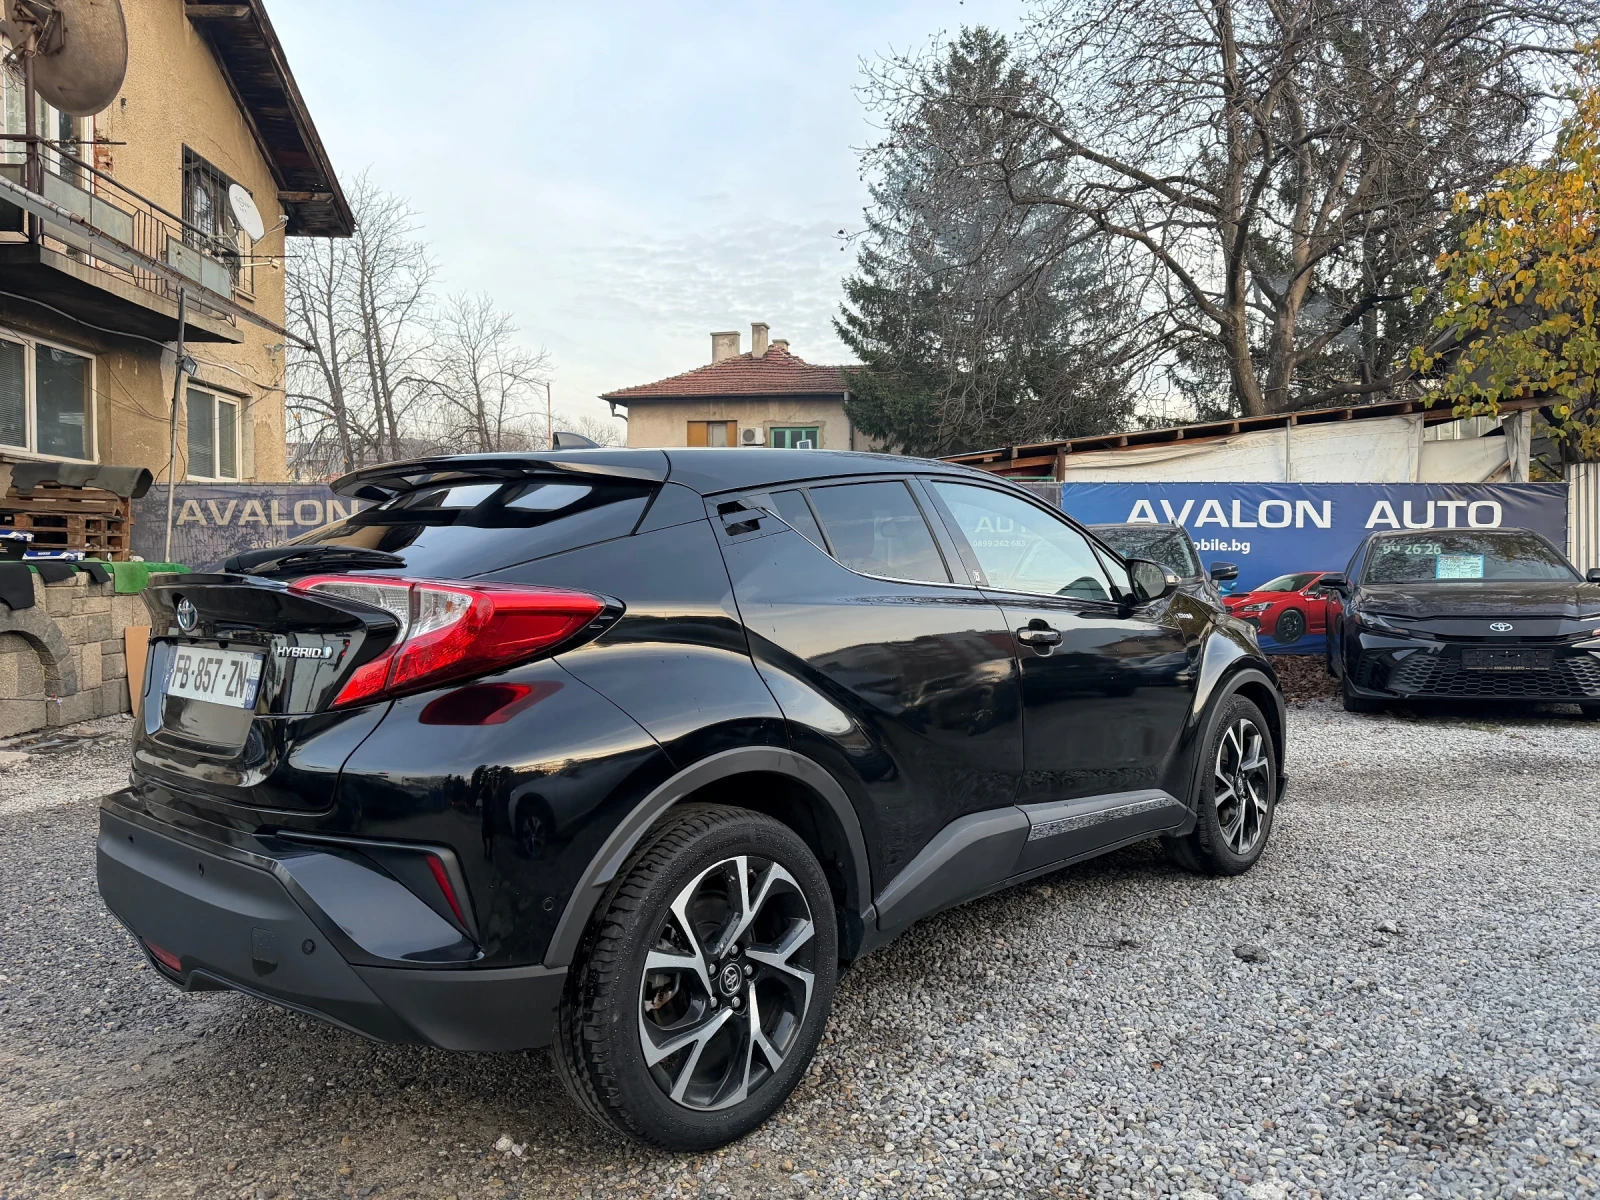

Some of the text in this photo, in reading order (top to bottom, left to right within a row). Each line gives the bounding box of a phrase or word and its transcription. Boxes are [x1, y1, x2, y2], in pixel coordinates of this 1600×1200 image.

[176, 499, 359, 526] AVALON
[1126, 499, 1503, 529] AVALON AUTO
[972, 539, 1026, 548] 0899 262 683
[277, 646, 322, 659] HYBRID
